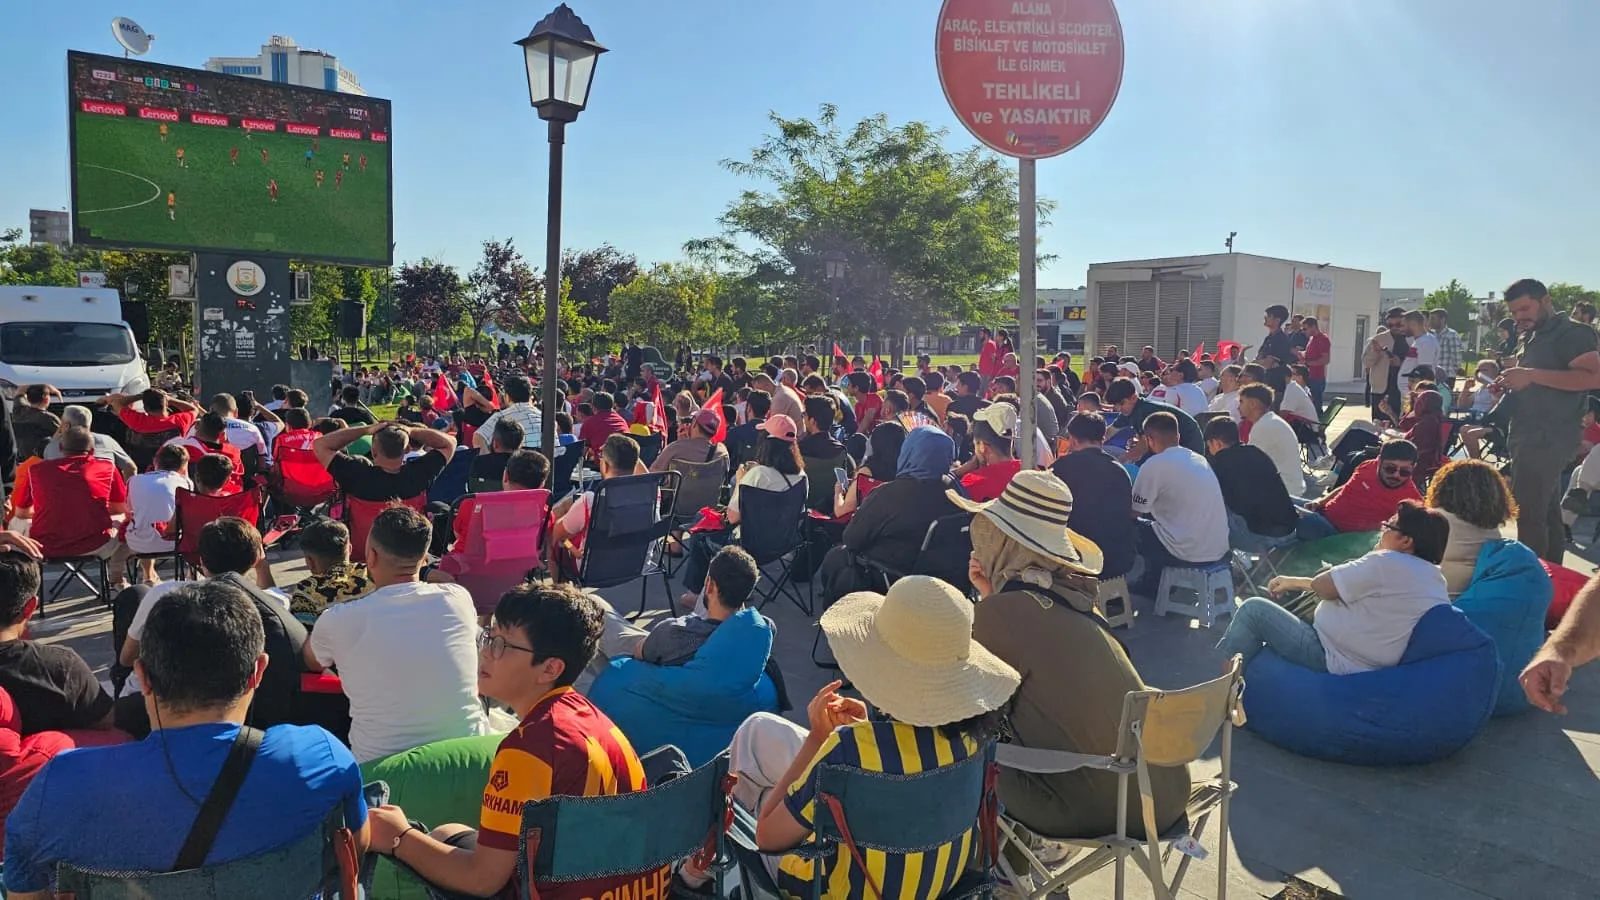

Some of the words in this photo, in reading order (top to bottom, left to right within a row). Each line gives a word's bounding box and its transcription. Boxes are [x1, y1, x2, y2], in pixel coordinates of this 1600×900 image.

[1011, 2, 1051, 15] ALANA
[944, 19, 982, 36] ARAÇ,
[985, 18, 1055, 36] ELEKTRİKLİ
[953, 36, 1010, 53] BİSİKLET
[1013, 40, 1029, 53] VE
[1032, 39, 1107, 55] MOTOSİKLET
[997, 56, 1016, 72] İLE
[1020, 56, 1067, 73] GİRMEK
[982, 79, 1081, 101] TEHLİKELİ
[83, 102, 125, 115] Lenovo
[141, 108, 178, 121] Lenovo
[192, 114, 228, 127] Lenovo
[971, 111, 993, 124] ve
[999, 108, 1092, 125] YASAKTIR
[242, 119, 276, 131] Lenovo
[287, 124, 319, 136] Lenovo
[330, 129, 361, 139] Lenovo
[483, 793, 523, 817] RKHAM
